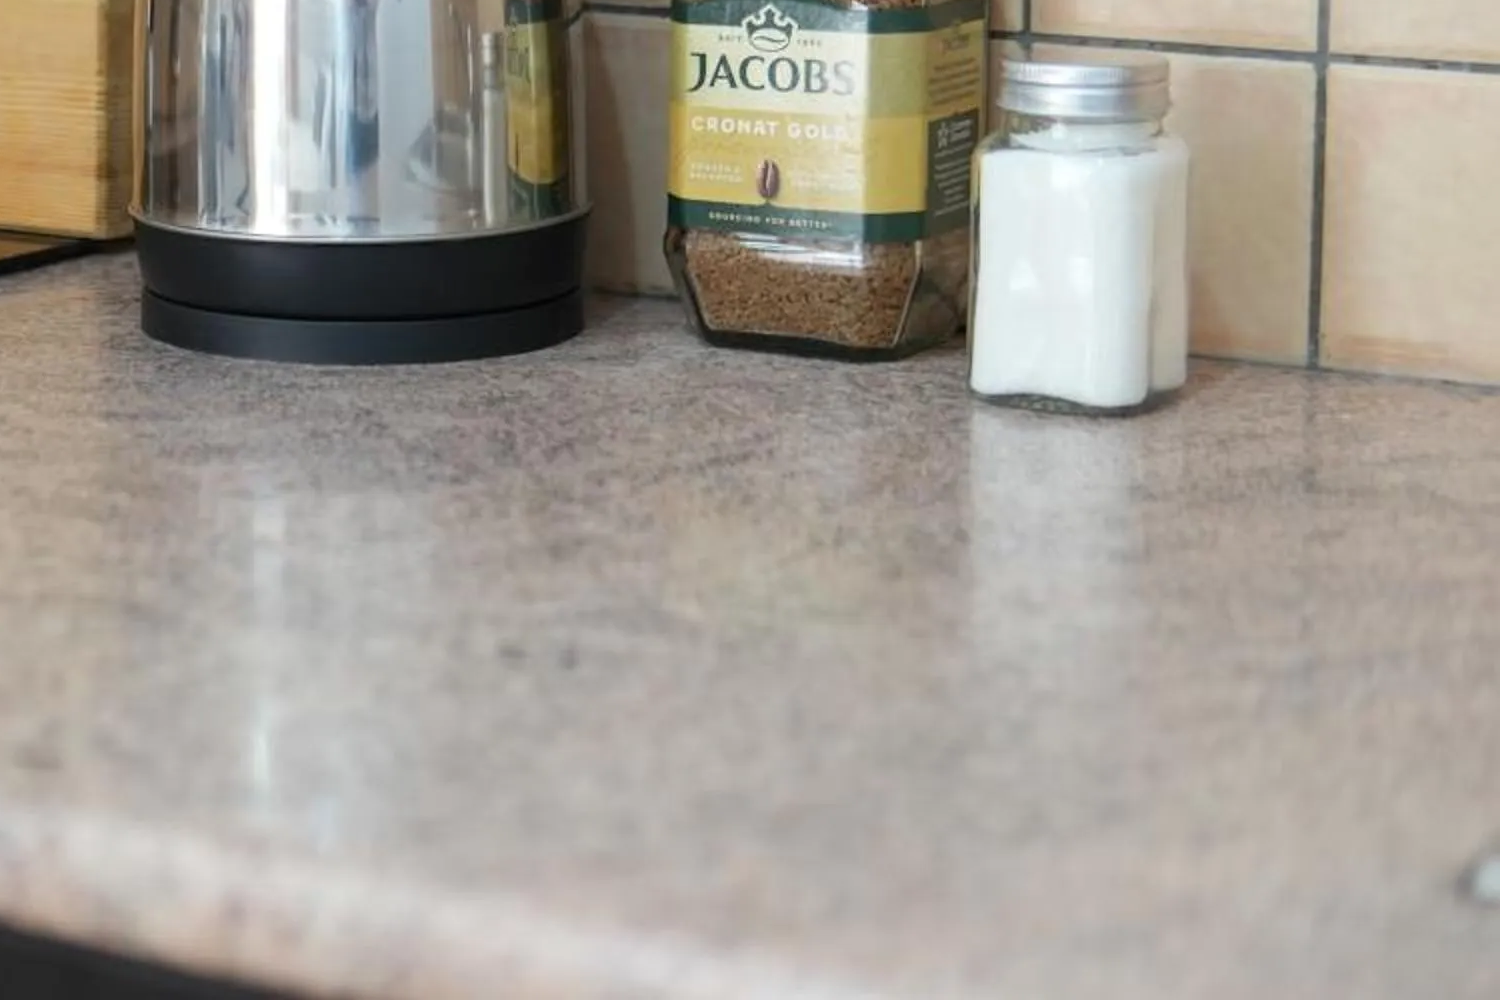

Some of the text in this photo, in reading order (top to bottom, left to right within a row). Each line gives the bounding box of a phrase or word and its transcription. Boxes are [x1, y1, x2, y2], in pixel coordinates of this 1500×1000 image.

[688, 52, 856, 96] JACOBS
[690, 115, 849, 140] CRONAT GOLD
